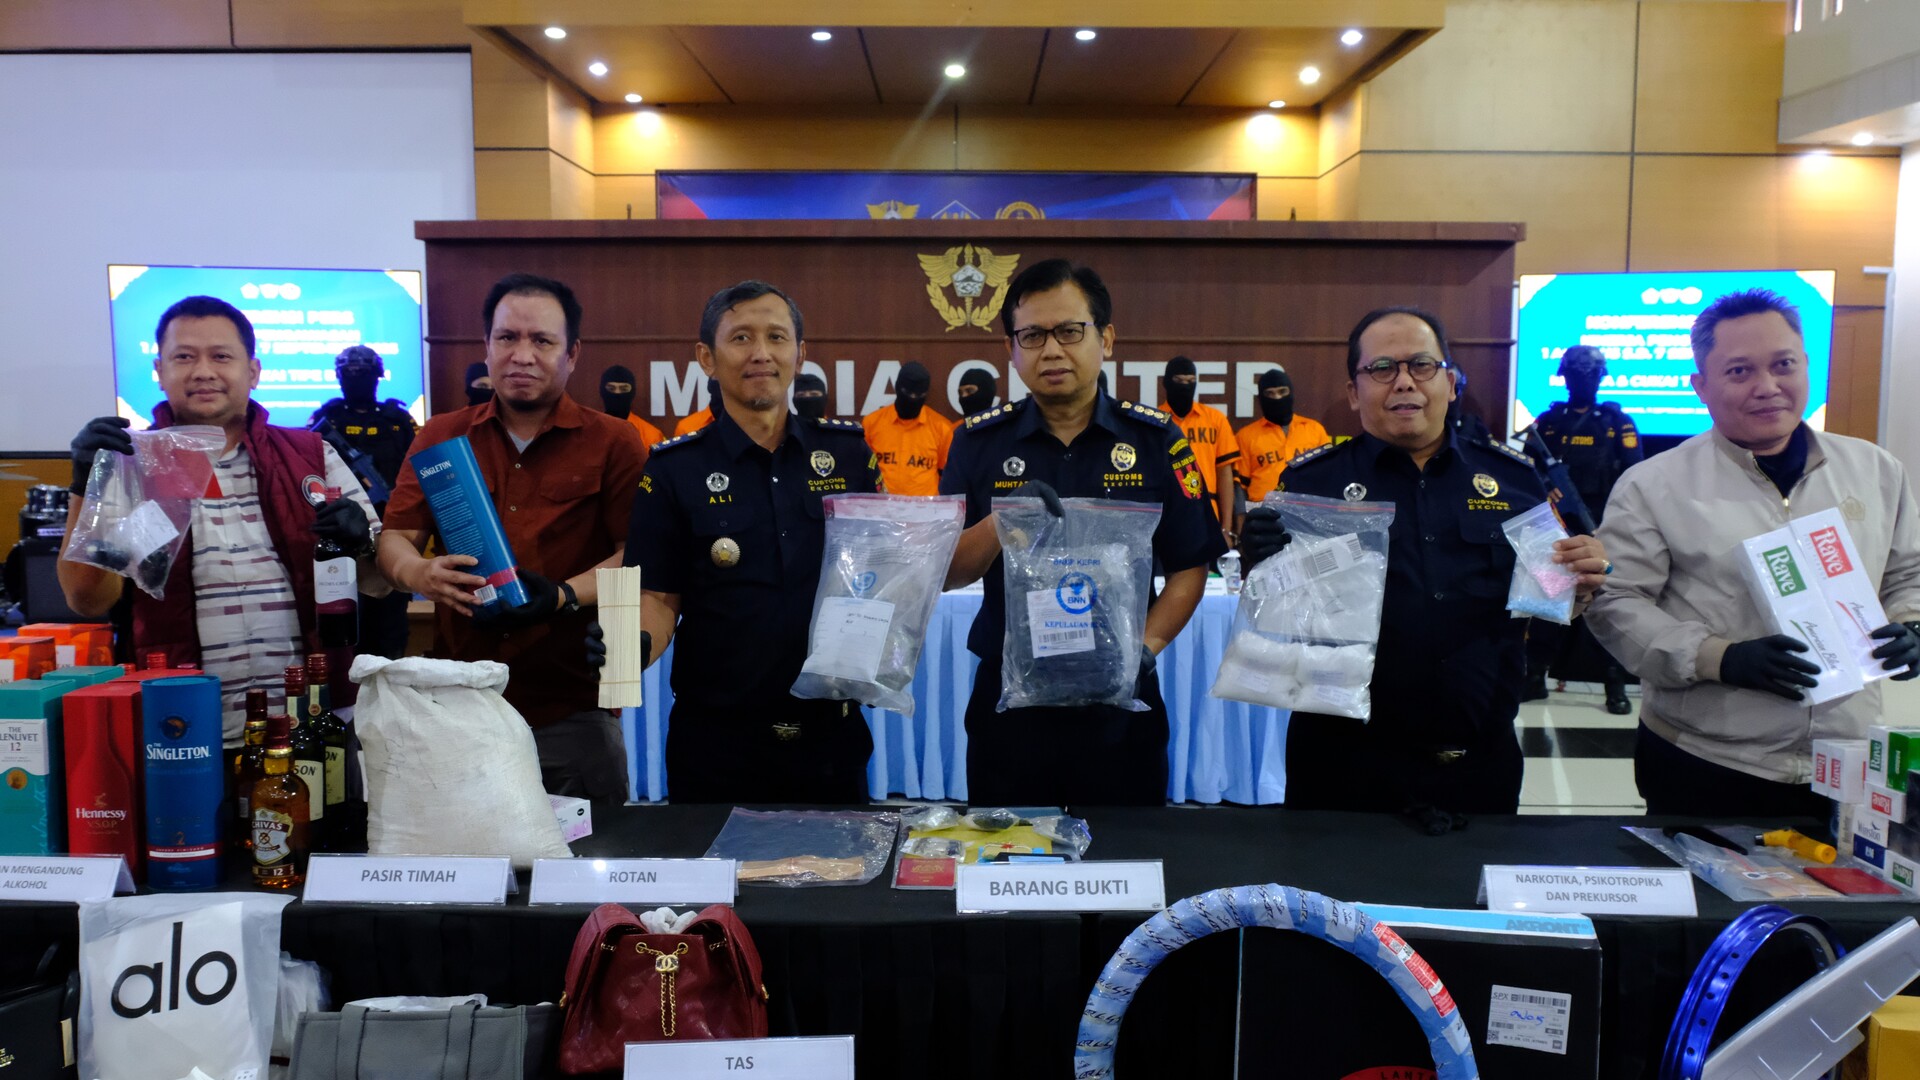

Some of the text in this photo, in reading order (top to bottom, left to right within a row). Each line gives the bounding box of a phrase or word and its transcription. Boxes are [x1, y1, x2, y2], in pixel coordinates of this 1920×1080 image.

[807, 477, 846, 486] CUSTOMS
[1103, 473, 1143, 482] CUSTOMS
[709, 494, 732, 504] ALI
[1467, 498, 1510, 507] CUSTOMS
[1813, 528, 1844, 574] Rave
[1766, 549, 1797, 593] Rave
[0, 733, 38, 742] LENLIVET
[10, 742, 21, 752] 12
[146, 744, 210, 760] SINGLETON
[75, 807, 127, 821] Hennessy
[252, 821, 283, 831] CHIVAS
[1857, 820, 1881, 841] Winston
[10, 865, 84, 876] MENGANDUNG
[273, 868, 284, 876] 12
[361, 869, 456, 882] PASIR TIMAH
[609, 871, 658, 884] ROTAN
[1515, 874, 1664, 888] NARKOTIKA, PSIKOTROPIKA
[3, 880, 48, 889] ALKOHOL
[988, 879, 1129, 897] BARANG BUKTI
[1546, 890, 1638, 903] DAN PREKURSOR
[111, 921, 238, 1019] alo
[725, 1056, 754, 1070] TAS
